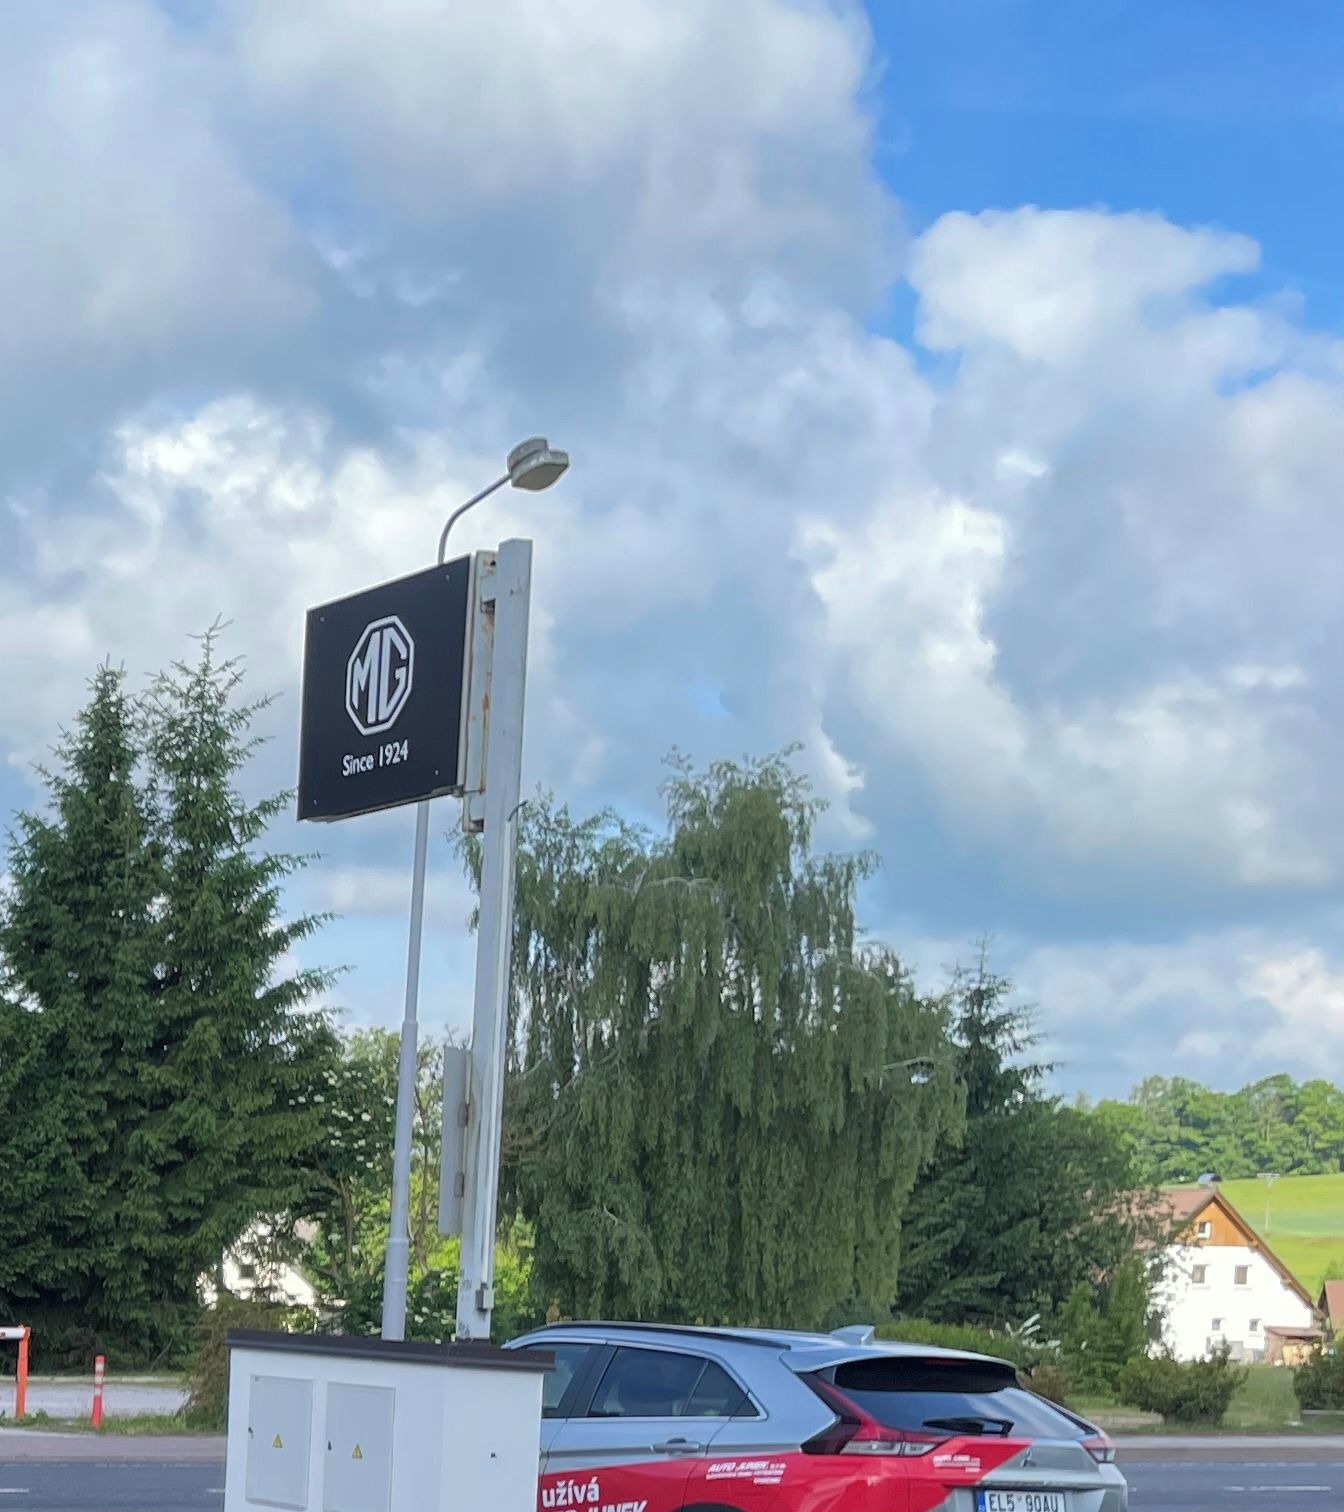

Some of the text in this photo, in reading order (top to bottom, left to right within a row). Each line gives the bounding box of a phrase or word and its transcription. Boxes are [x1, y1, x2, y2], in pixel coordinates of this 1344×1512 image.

[352, 626, 408, 725] MG
[342, 739, 409, 777] Since 1924
[542, 1476, 600, 1508] užívá
